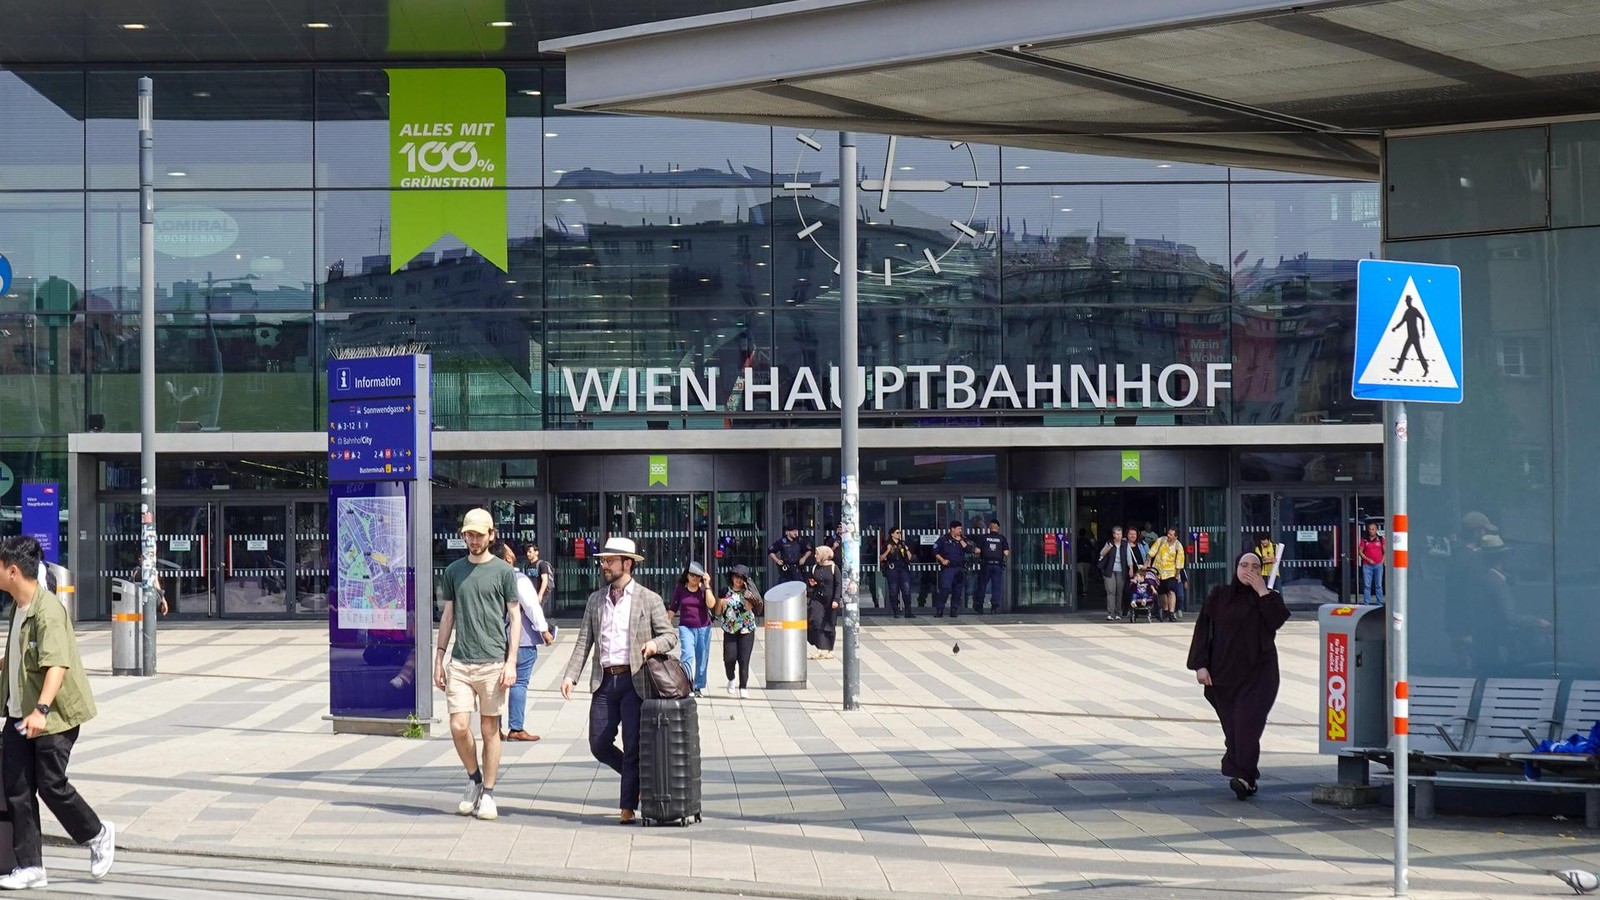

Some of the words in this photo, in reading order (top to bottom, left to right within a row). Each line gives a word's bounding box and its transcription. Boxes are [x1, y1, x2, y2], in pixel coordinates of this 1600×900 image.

[399, 123, 453, 136] ALLES
[460, 123, 495, 136] MIT
[399, 141, 495, 172] 100%
[400, 176, 494, 187] GRÜNSTROM
[355, 375, 401, 388] Information
[562, 367, 717, 412] WIEN
[744, 362, 1232, 411] HAUPTBAHNHOF
[363, 405, 405, 415] Sonnwendgasse
